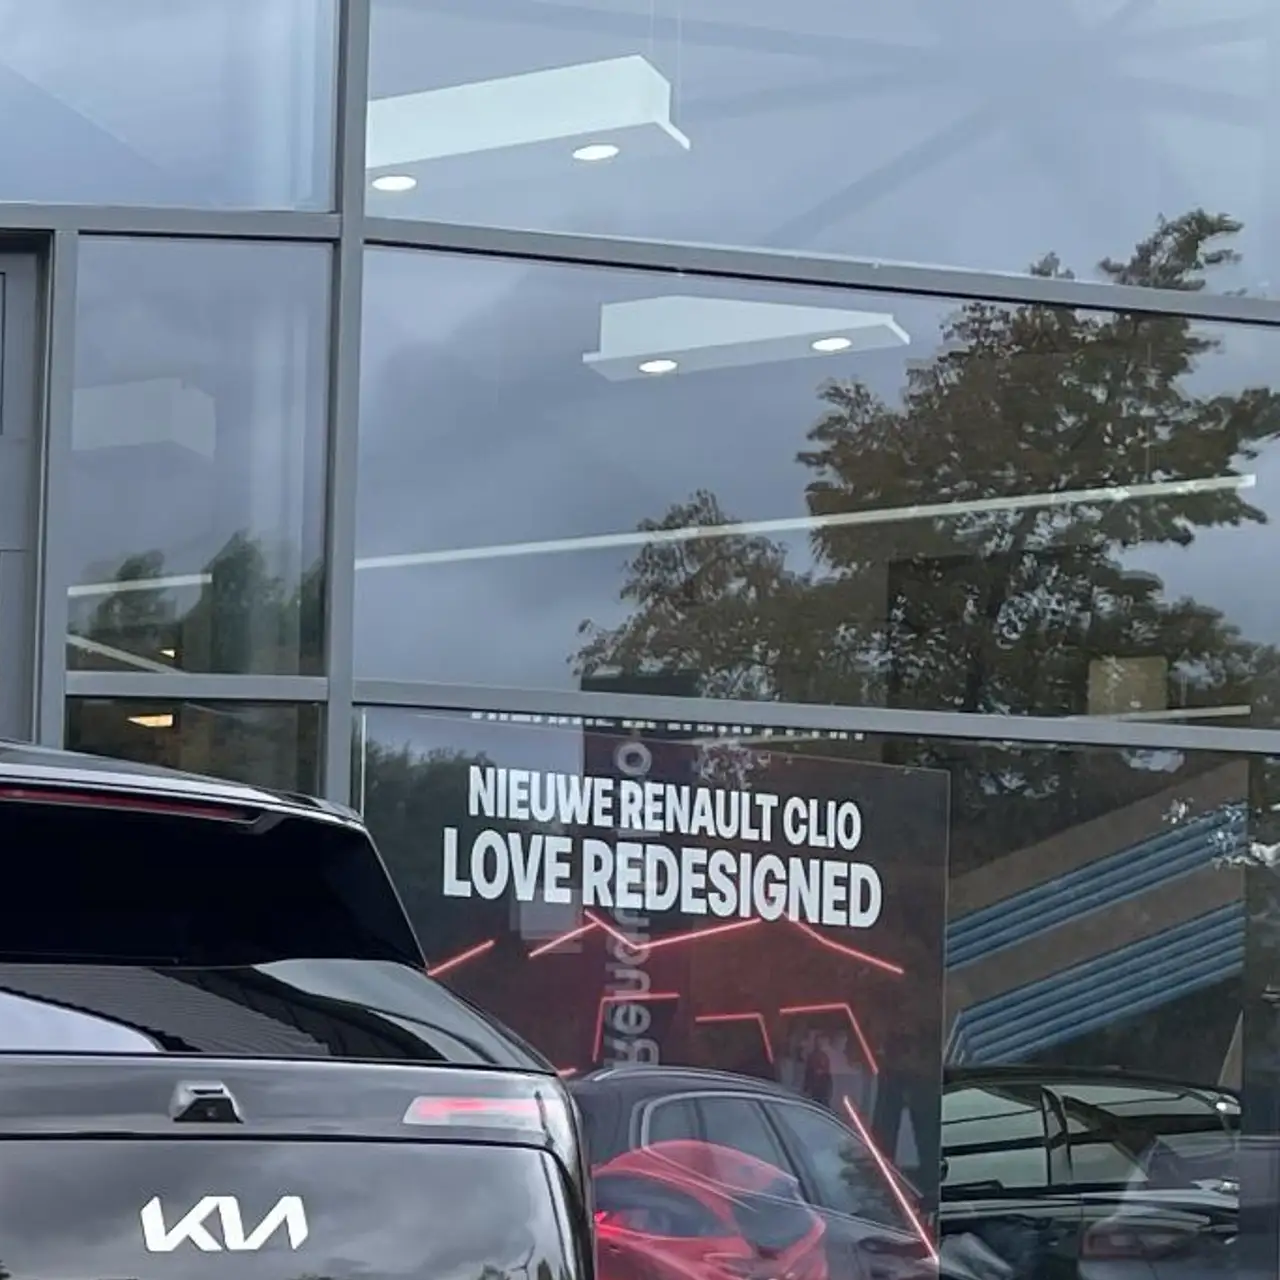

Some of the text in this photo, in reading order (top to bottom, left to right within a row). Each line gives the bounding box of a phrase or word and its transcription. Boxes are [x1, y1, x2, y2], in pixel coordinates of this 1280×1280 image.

[468, 766, 613, 828] NIEUWE
[620, 777, 778, 842] RENAULT
[783, 797, 862, 851] CLIO
[443, 827, 882, 928] LOVE REDESIGNED
[141, 1196, 308, 1251] KIA
